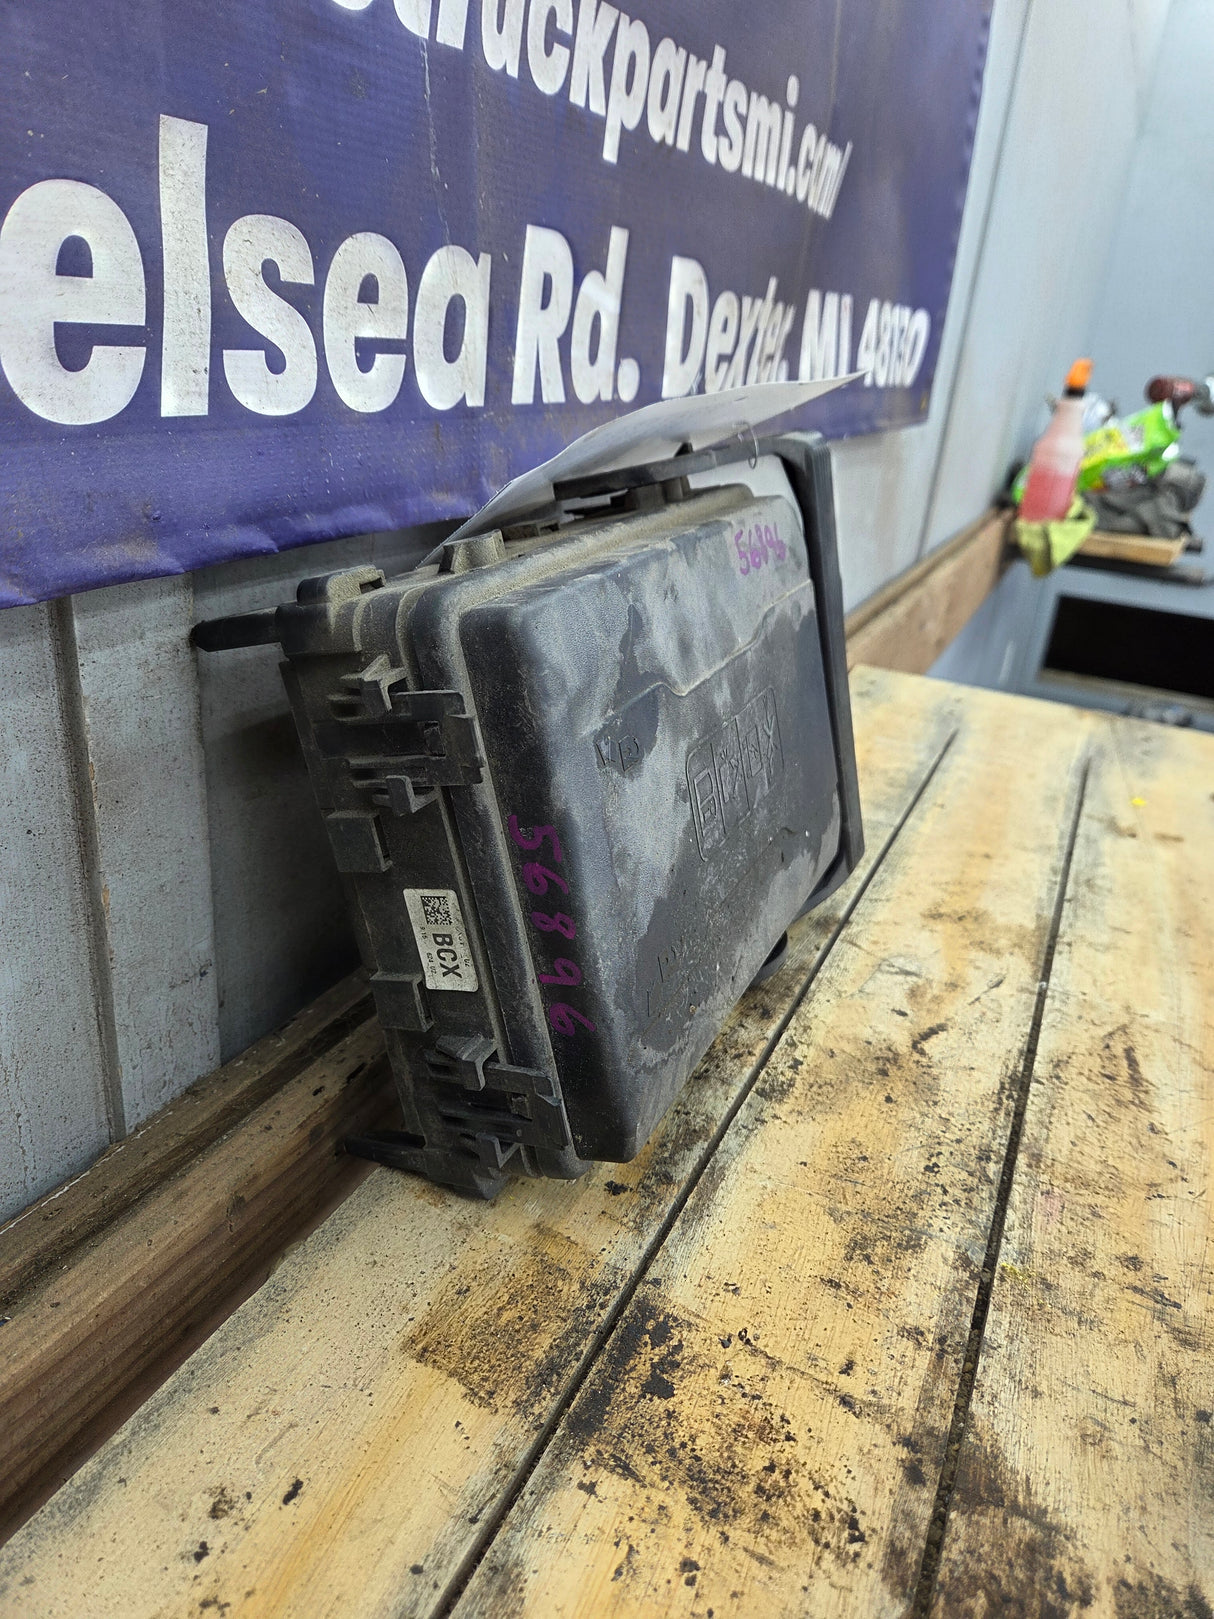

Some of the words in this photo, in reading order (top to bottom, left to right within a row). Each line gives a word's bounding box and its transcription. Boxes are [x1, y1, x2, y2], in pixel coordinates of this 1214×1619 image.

[512, 224, 640, 404] Rd.
[798, 288, 853, 382] MI
[432, 933, 462, 978] BCX
